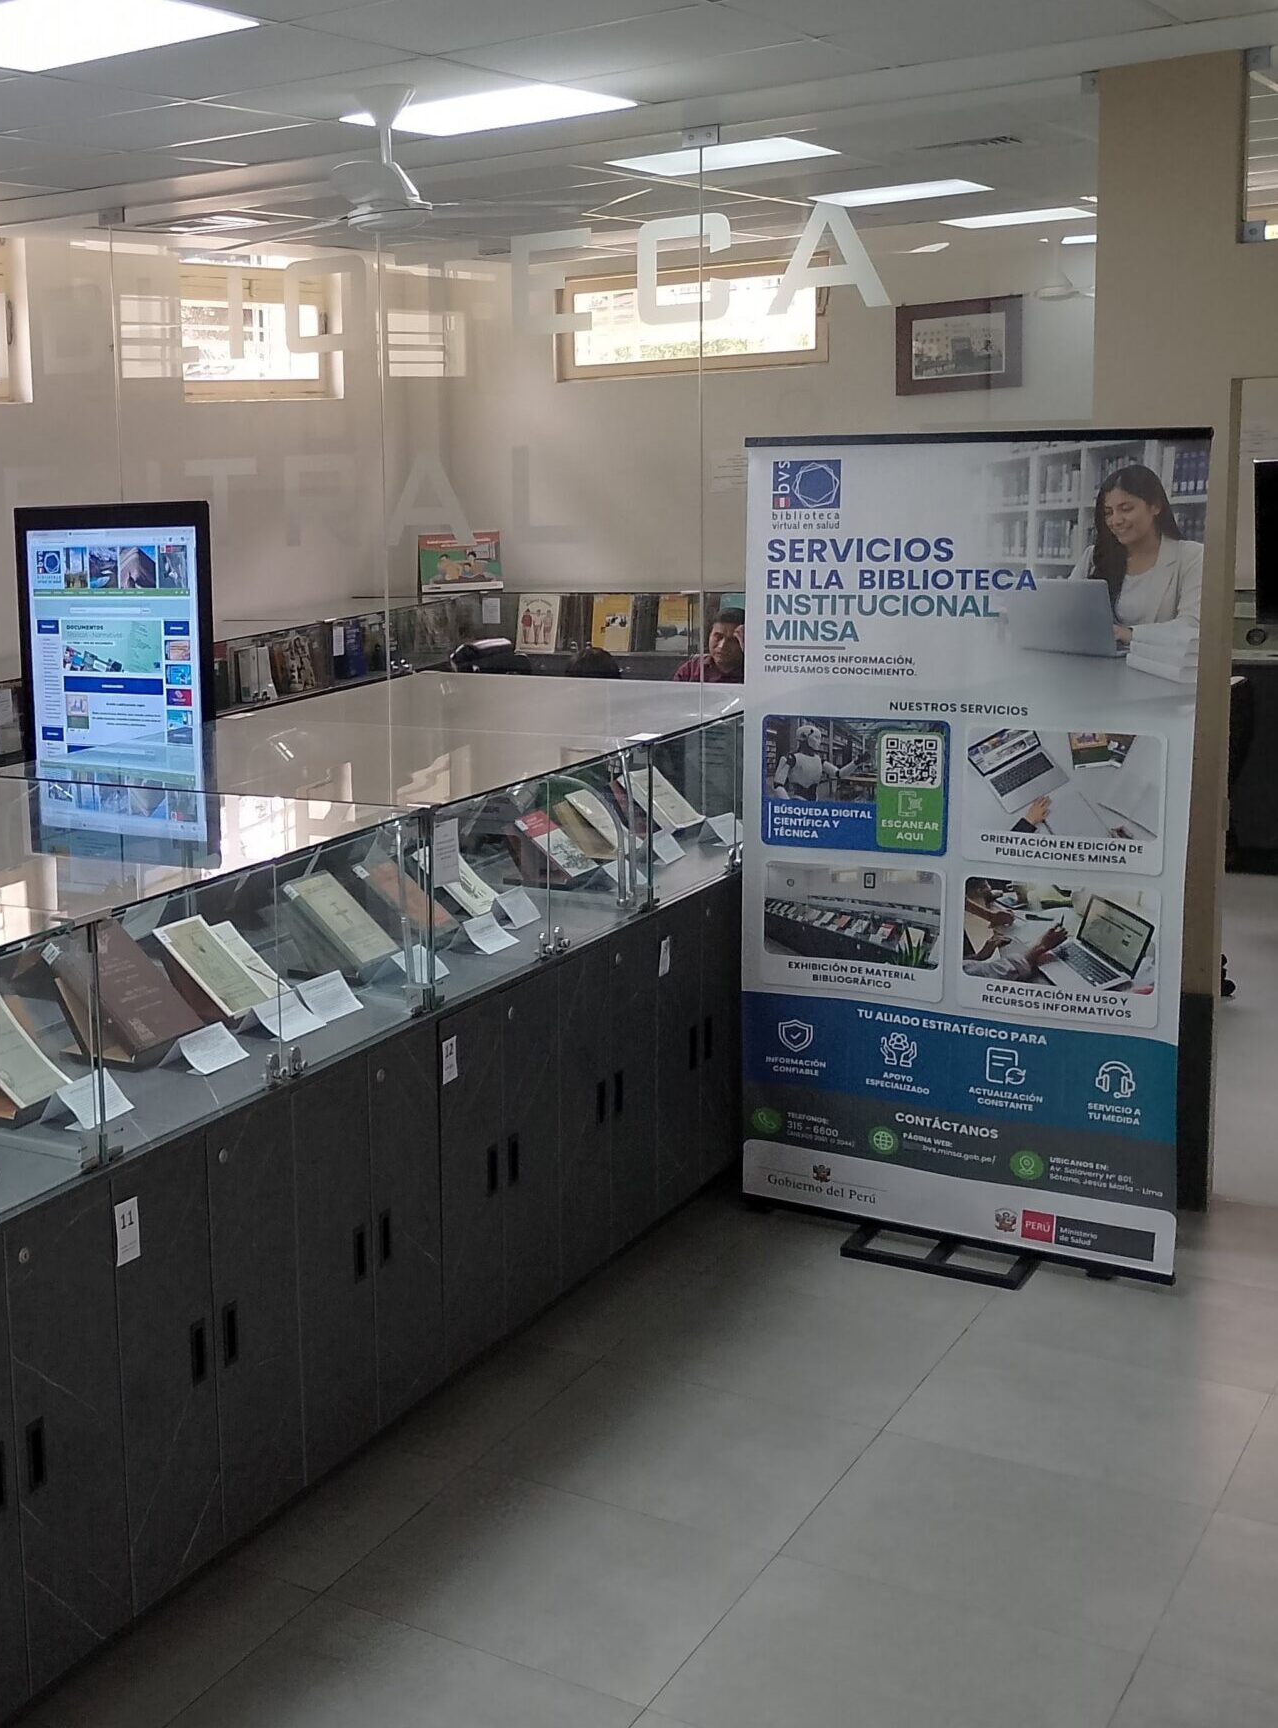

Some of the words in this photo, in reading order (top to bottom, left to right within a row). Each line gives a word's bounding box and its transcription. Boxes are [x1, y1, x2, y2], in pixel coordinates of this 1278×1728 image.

[772, 461, 790, 494] bvs
[772, 511, 840, 521] biblioteca
[772, 521, 800, 529] virtual
[803, 522, 813, 530] en
[816, 521, 840, 530] salud
[767, 537, 954, 563] SERVICIOS
[767, 570, 802, 590] EN
[810, 569, 844, 590] LA
[858, 570, 1037, 591] BIBLIOTECA
[766, 595, 999, 618] INSTITUCIONAL
[765, 621, 859, 642] MINSA
[764, 654, 836, 663] CONECTAMOS
[838, 655, 915, 666] INFORMACIÓN,
[764, 665, 830, 674] IMPULSAMOS
[832, 666, 917, 676] CONOCIMIENTO.
[890, 702, 956, 713] NUESTROS
[960, 703, 1028, 716] SERVICIOS
[774, 804, 829, 817] BÚSQUEDA
[832, 808, 872, 819] DIGITAL
[774, 816, 830, 828] CIENTÍFICA
[832, 820, 840, 829] Y
[882, 819, 939, 831] ESCANEAR
[774, 826, 818, 839] TÉCNICA
[980, 834, 1057, 850] ORIENTACIÓN
[1060, 840, 1074, 850] EN
[1078, 839, 1126, 854] EDICIÓN
[1129, 844, 1143, 854] DE
[996, 846, 1085, 863] PUBLICACIONES
[1088, 853, 1126, 865] MINSA
[788, 959, 848, 974] EXHIBICIÓN
[850, 965, 864, 974] DE
[866, 966, 916, 982] MATERIAL
[812, 973, 892, 990] BIBLIOGRÁFICO
[986, 983, 1073, 1001] CAPACITACIÓN
[1076, 992, 1090, 1002] EN
[1093, 994, 1118, 1006] USO
[1119, 996, 1128, 1006] Y
[982, 994, 1040, 1010] RECURSOS
[1042, 1001, 1132, 1018] INFORMATIVOS
[857, 1008, 872, 1019] TU
[875, 1010, 920, 1026] ALIADO
[922, 1018, 1008, 1040] ESTRATÉGICO
[1010, 1032, 1047, 1046] PARA
[766, 1056, 826, 1068] INFORMACIÓN
[772, 1065, 819, 1076] CONFIABLE
[883, 1072, 913, 1083] APOYO
[866, 1078, 930, 1095] ESPECIALIZADO
[968, 1086, 1043, 1103] ACTUALIZACIÓN
[978, 1096, 1034, 1111] CONSTANTE
[1088, 1102, 1131, 1115] SERVICIO
[1134, 1108, 1141, 1116] A
[895, 1112, 998, 1139] CONTÁCTANOS
[1088, 1112, 1100, 1121] TU
[1102, 1113, 1140, 1126] MEDIDA
[768, 1174, 822, 1193] Gobierno
[826, 1185, 844, 1198] del
[849, 1189, 876, 1204] Perú
[120, 1210, 134, 1230] 11
[1025, 1220, 1051, 1234] PERÚ
[1059, 1234, 1070, 1242] de
[1071, 1236, 1091, 1246] Salud
[1060, 1226, 1098, 1240] Ministerio
